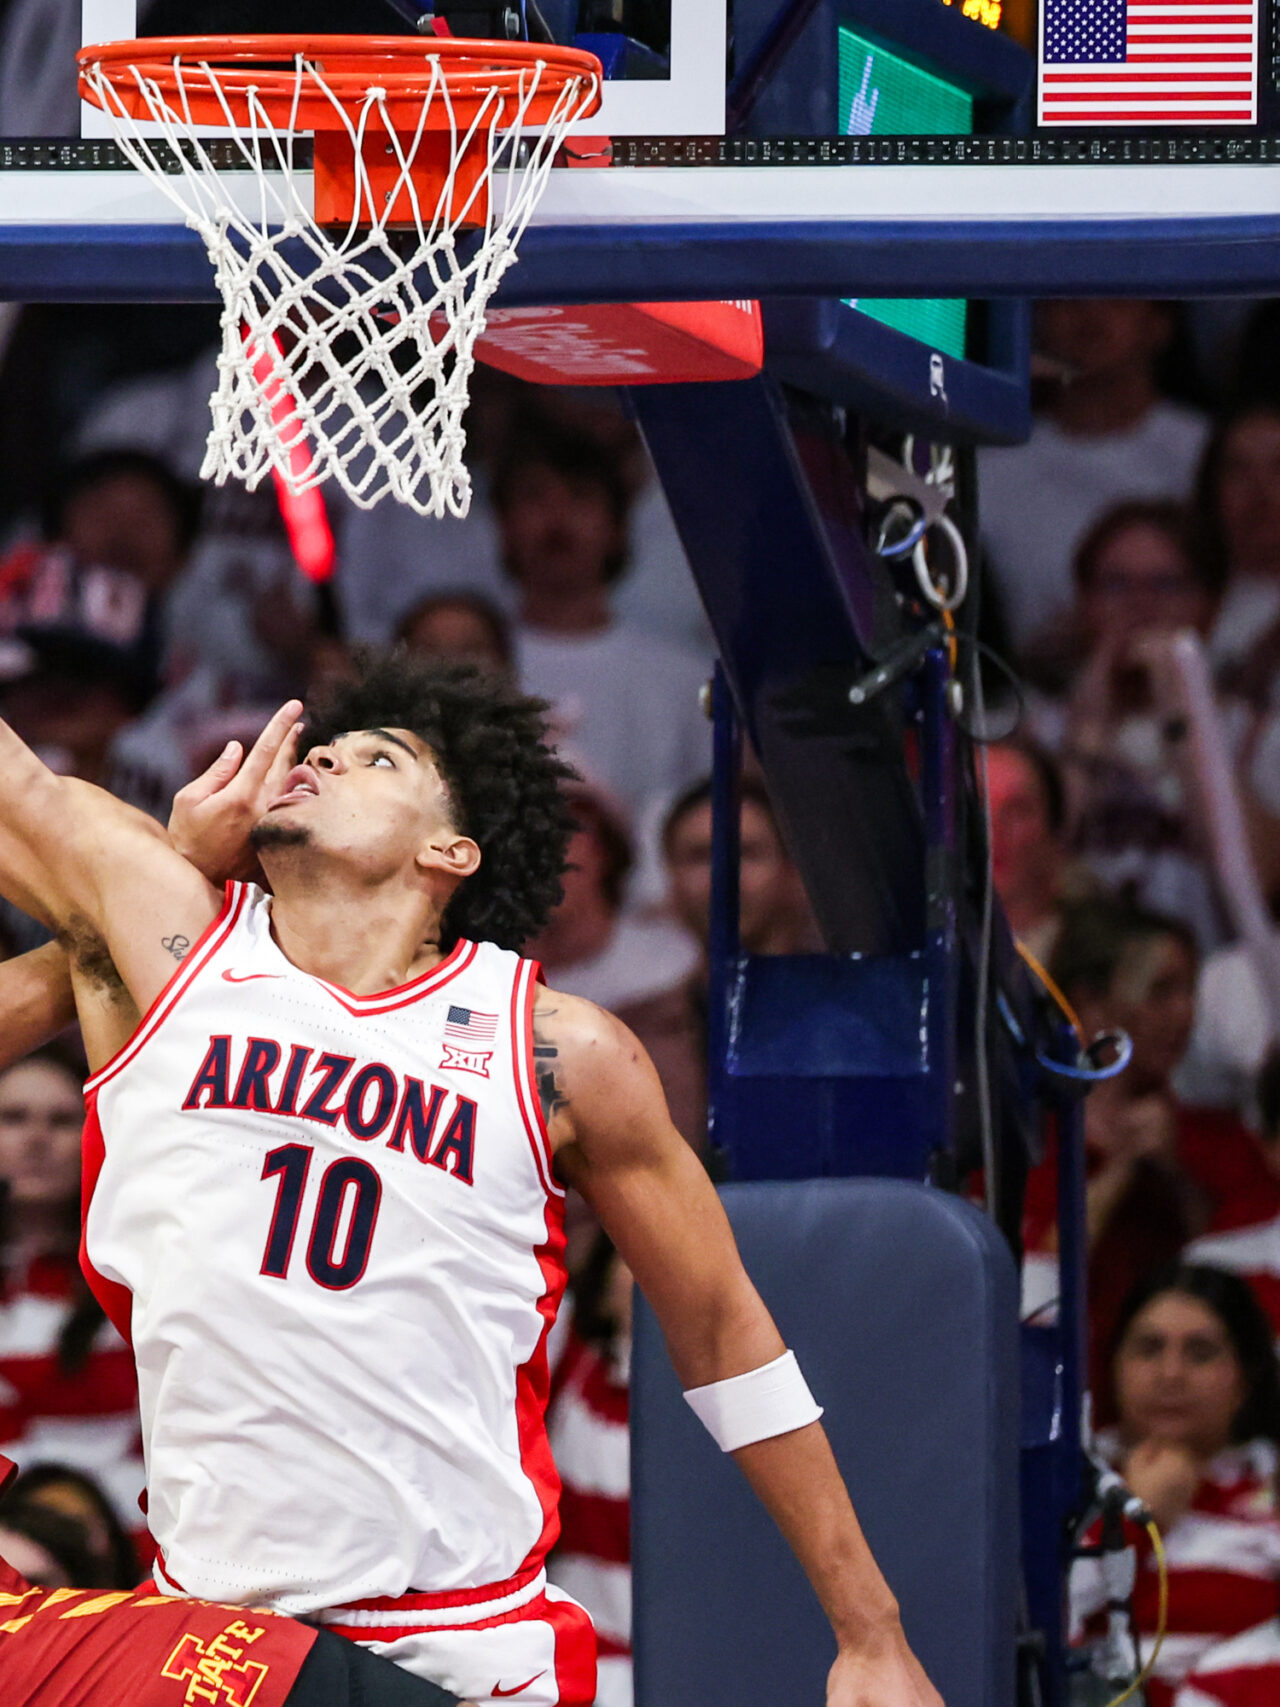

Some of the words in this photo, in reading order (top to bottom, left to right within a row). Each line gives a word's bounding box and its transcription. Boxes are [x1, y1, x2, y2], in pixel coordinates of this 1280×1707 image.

[181, 1034, 478, 1187] ARIZONA
[439, 1044, 493, 1079] XII
[259, 1142, 382, 1291] 10
[183, 1619, 266, 1707] TATE
